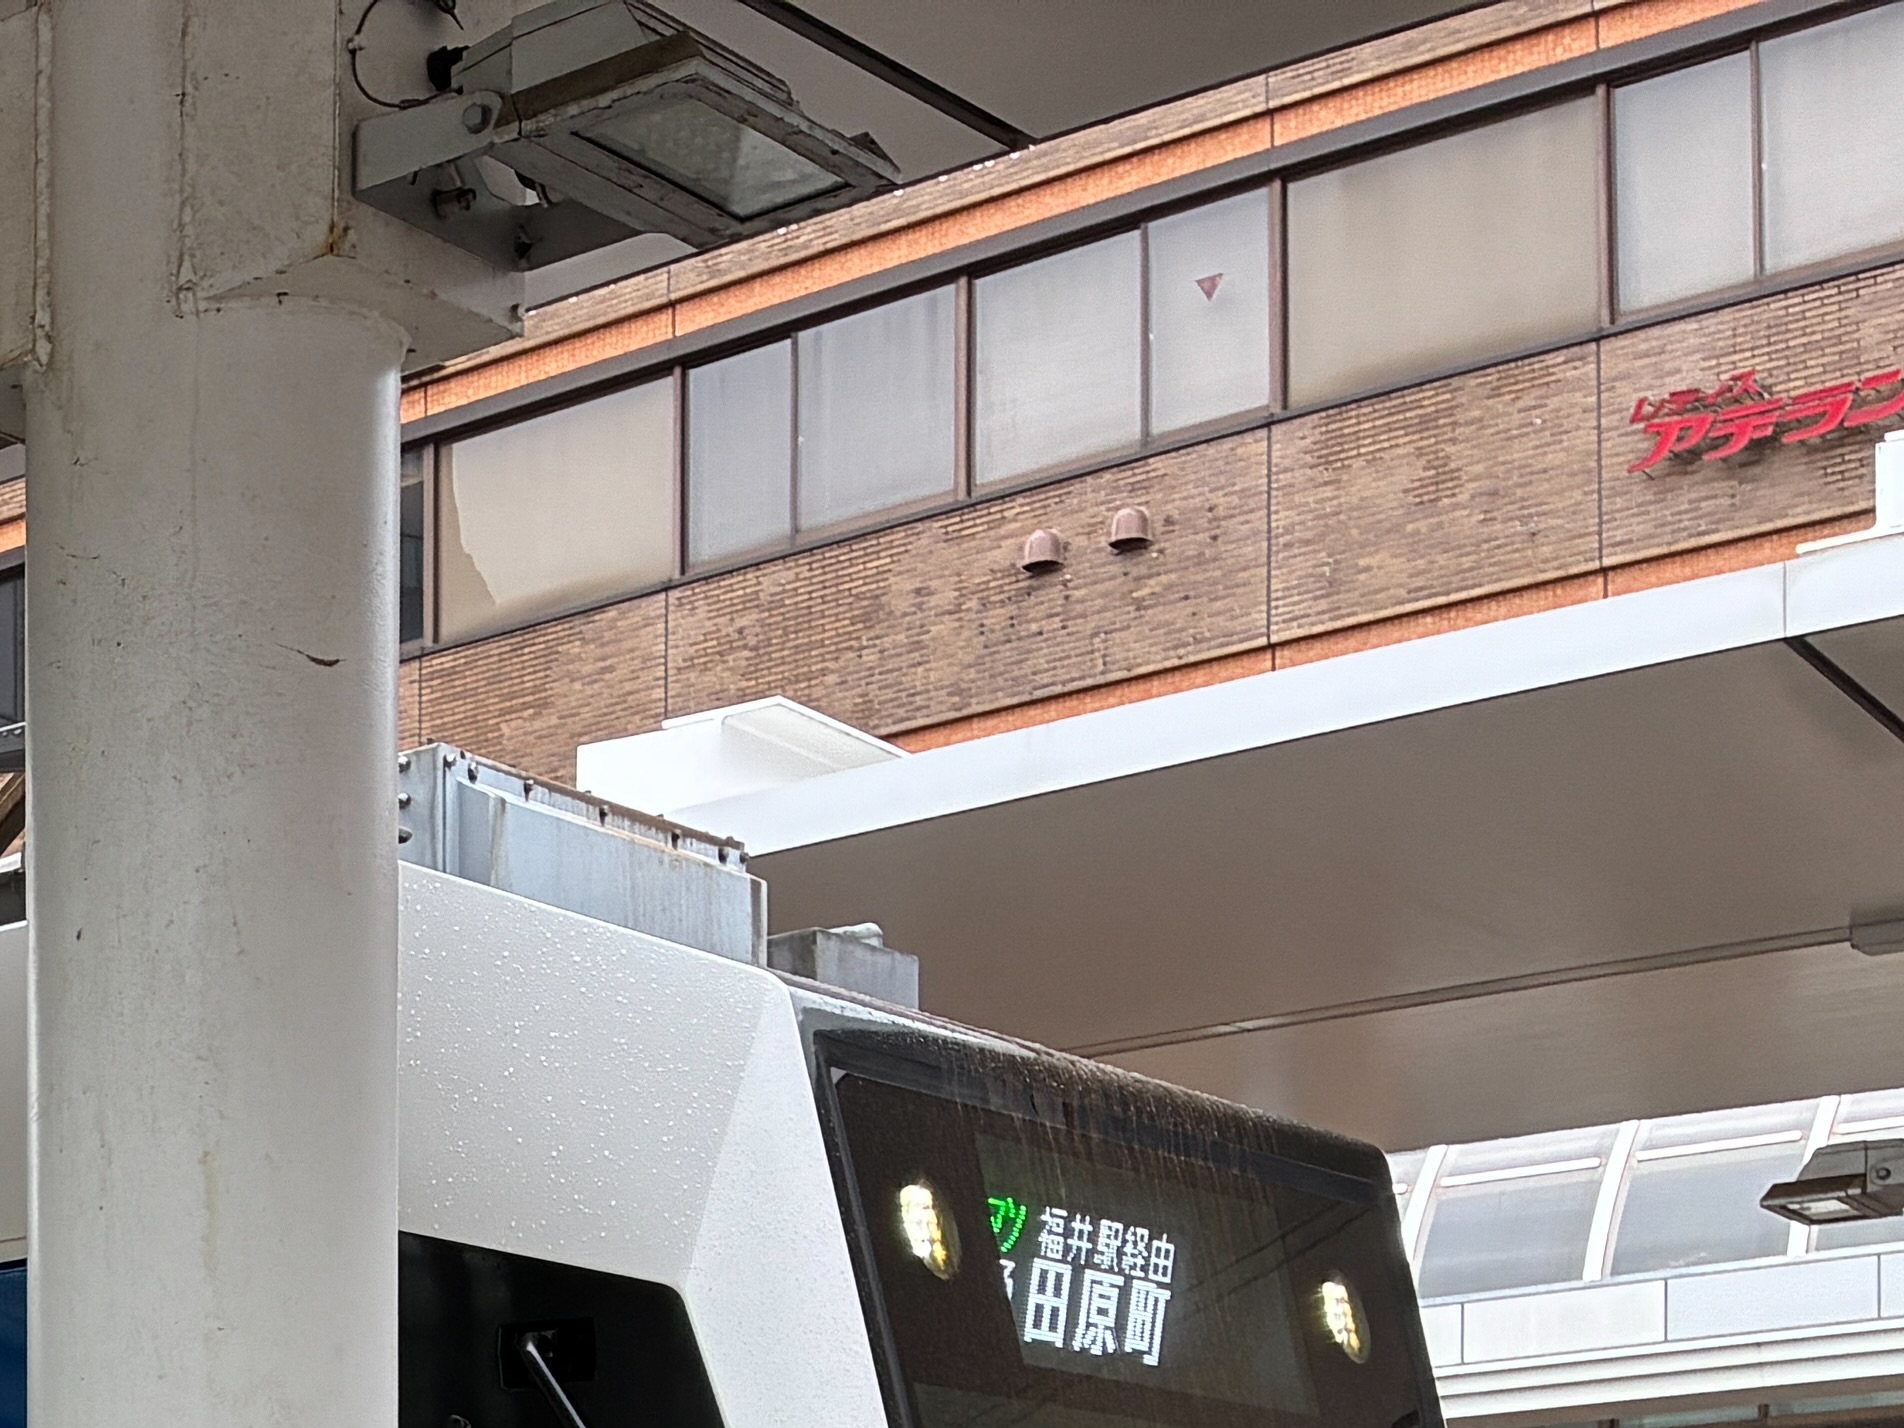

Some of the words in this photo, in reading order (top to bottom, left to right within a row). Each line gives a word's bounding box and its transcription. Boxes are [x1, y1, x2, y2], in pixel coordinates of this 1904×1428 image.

[1038, 1206, 1175, 1284] 福井駅経由
[1024, 1257, 1172, 1367] 田原町
